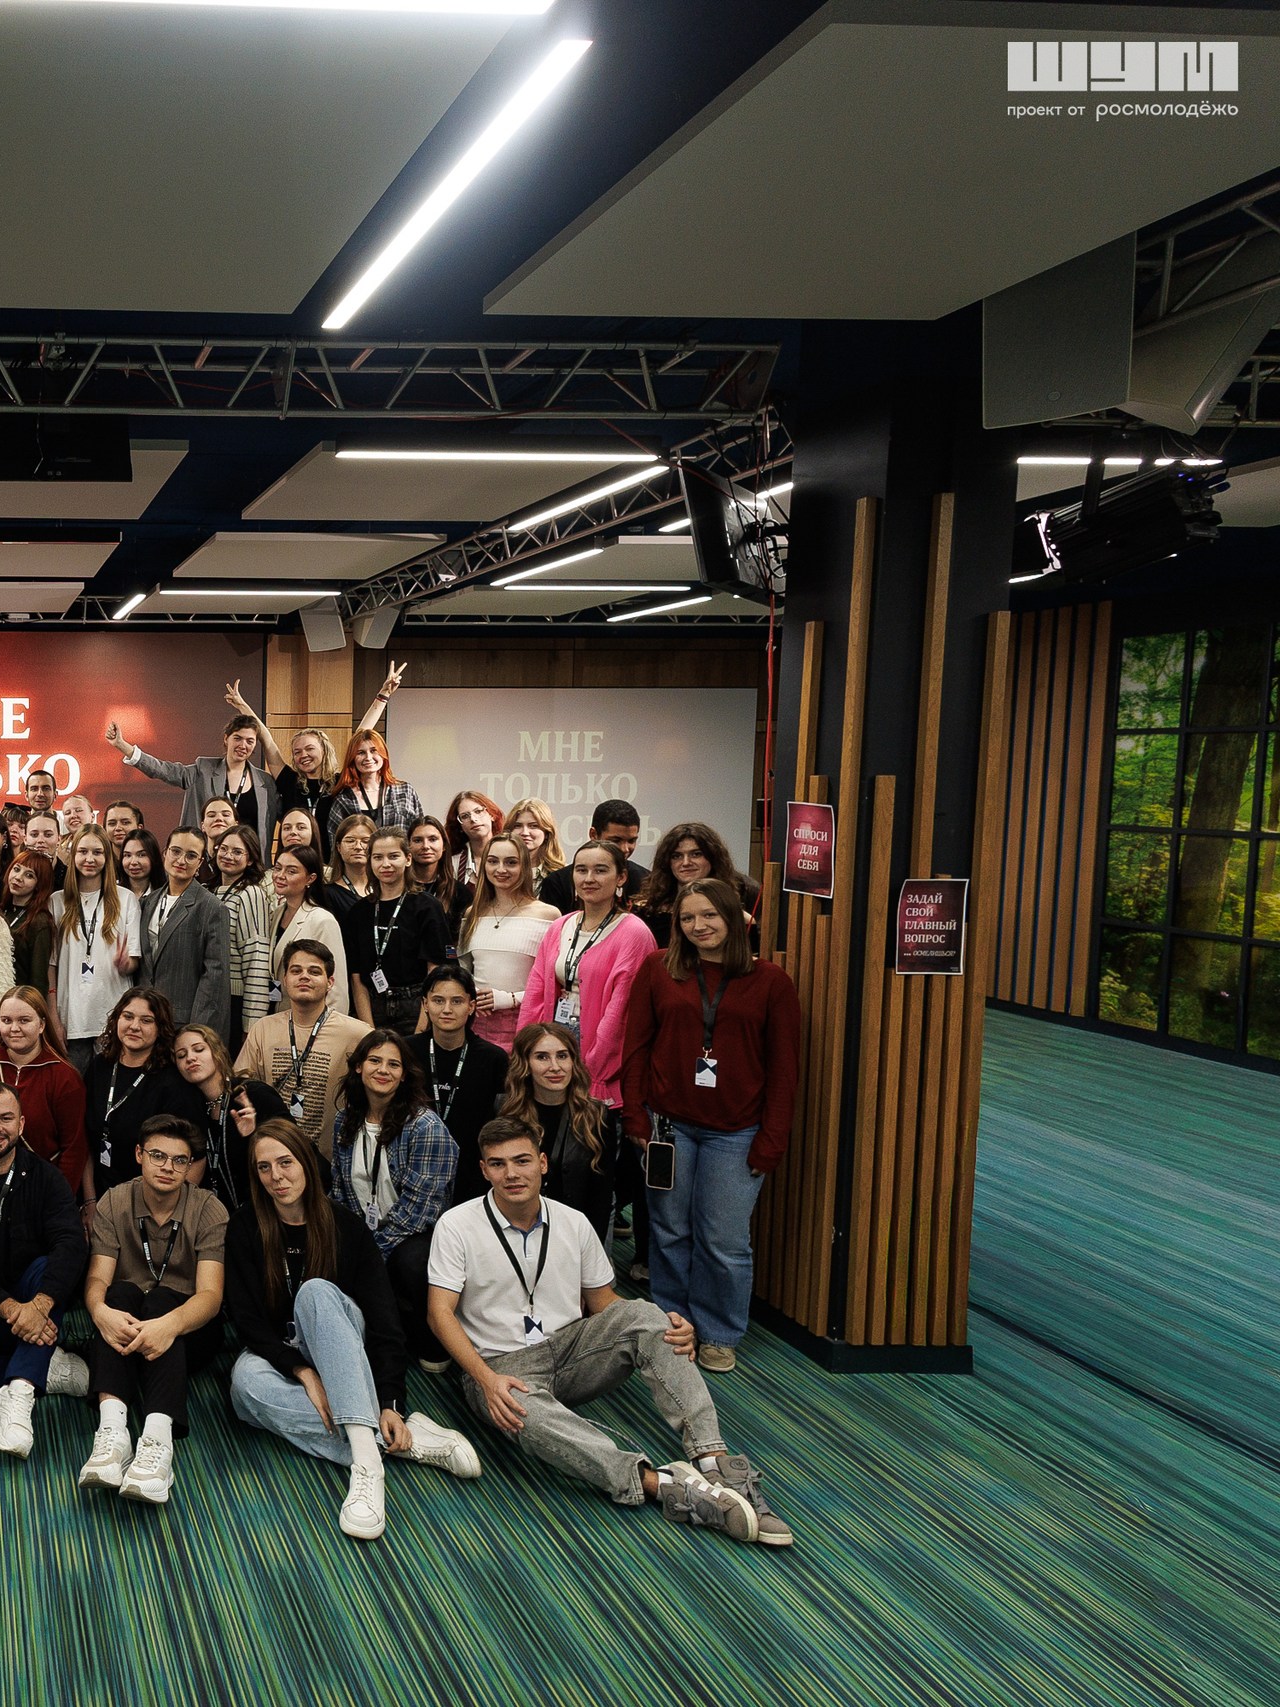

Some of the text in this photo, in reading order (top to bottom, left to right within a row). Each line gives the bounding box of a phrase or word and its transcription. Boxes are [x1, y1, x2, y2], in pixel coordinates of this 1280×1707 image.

[517, 731, 604, 763] МНЕ
[479, 772, 638, 804] ТОЛЬКО
[793, 828, 828, 842] СПРОСИ
[799, 844, 819, 856] ДЛЯ
[797, 858, 819, 872] СЕБЯ
[906, 892, 943, 905] ЗАДАЙ
[905, 905, 934, 917] СВОЙ
[904, 919, 957, 931] ГЛАВНЫЙ
[904, 934, 946, 943] ВОПРОС
